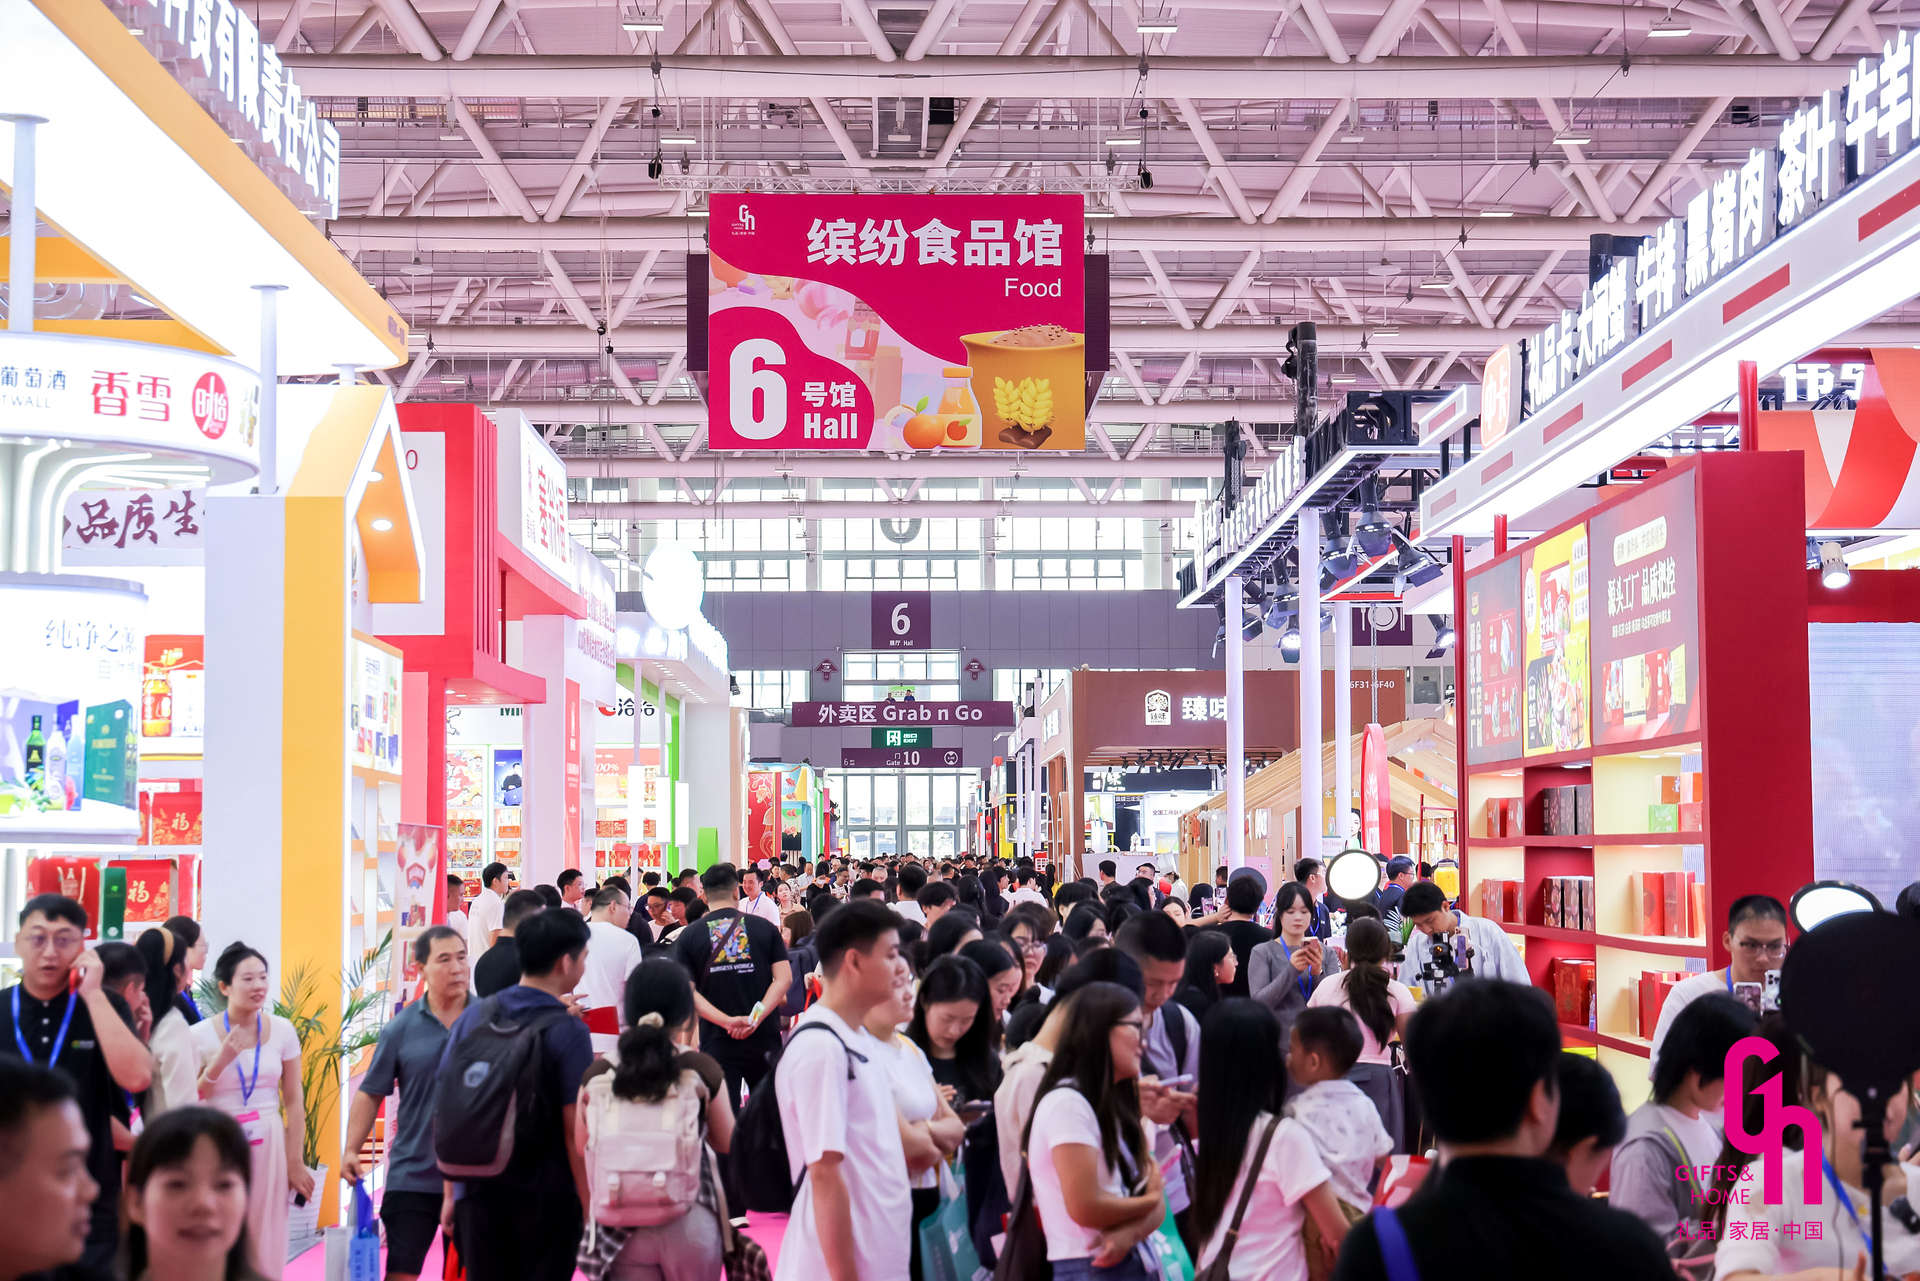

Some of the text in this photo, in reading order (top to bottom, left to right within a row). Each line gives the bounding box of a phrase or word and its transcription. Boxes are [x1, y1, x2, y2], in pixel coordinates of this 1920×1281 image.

[163, 0, 339, 220] 有限责任公司
[1635, 218, 1677, 330] 牛排
[1684, 147, 1765, 296] 黑猪肉
[1778, 89, 1836, 226] 茶叶
[1845, 29, 1920, 176] 牛羊
[806, 218, 1063, 267] 缤纷食品馆
[1004, 277, 1062, 297] Food
[1, 366, 66, 390] 葡萄酒
[729, 337, 788, 440] 6
[91, 370, 171, 423] 香雪
[801, 381, 857, 408] 号馆
[803, 412, 858, 439] Hall
[63, 489, 199, 549] 品质生
[890, 602, 912, 636] 6
[818, 704, 983, 723] 外卖区 Grab n Go
[903, 751, 920, 765] 10
[172, 812, 190, 831] 福
[128, 879, 150, 903] 福
